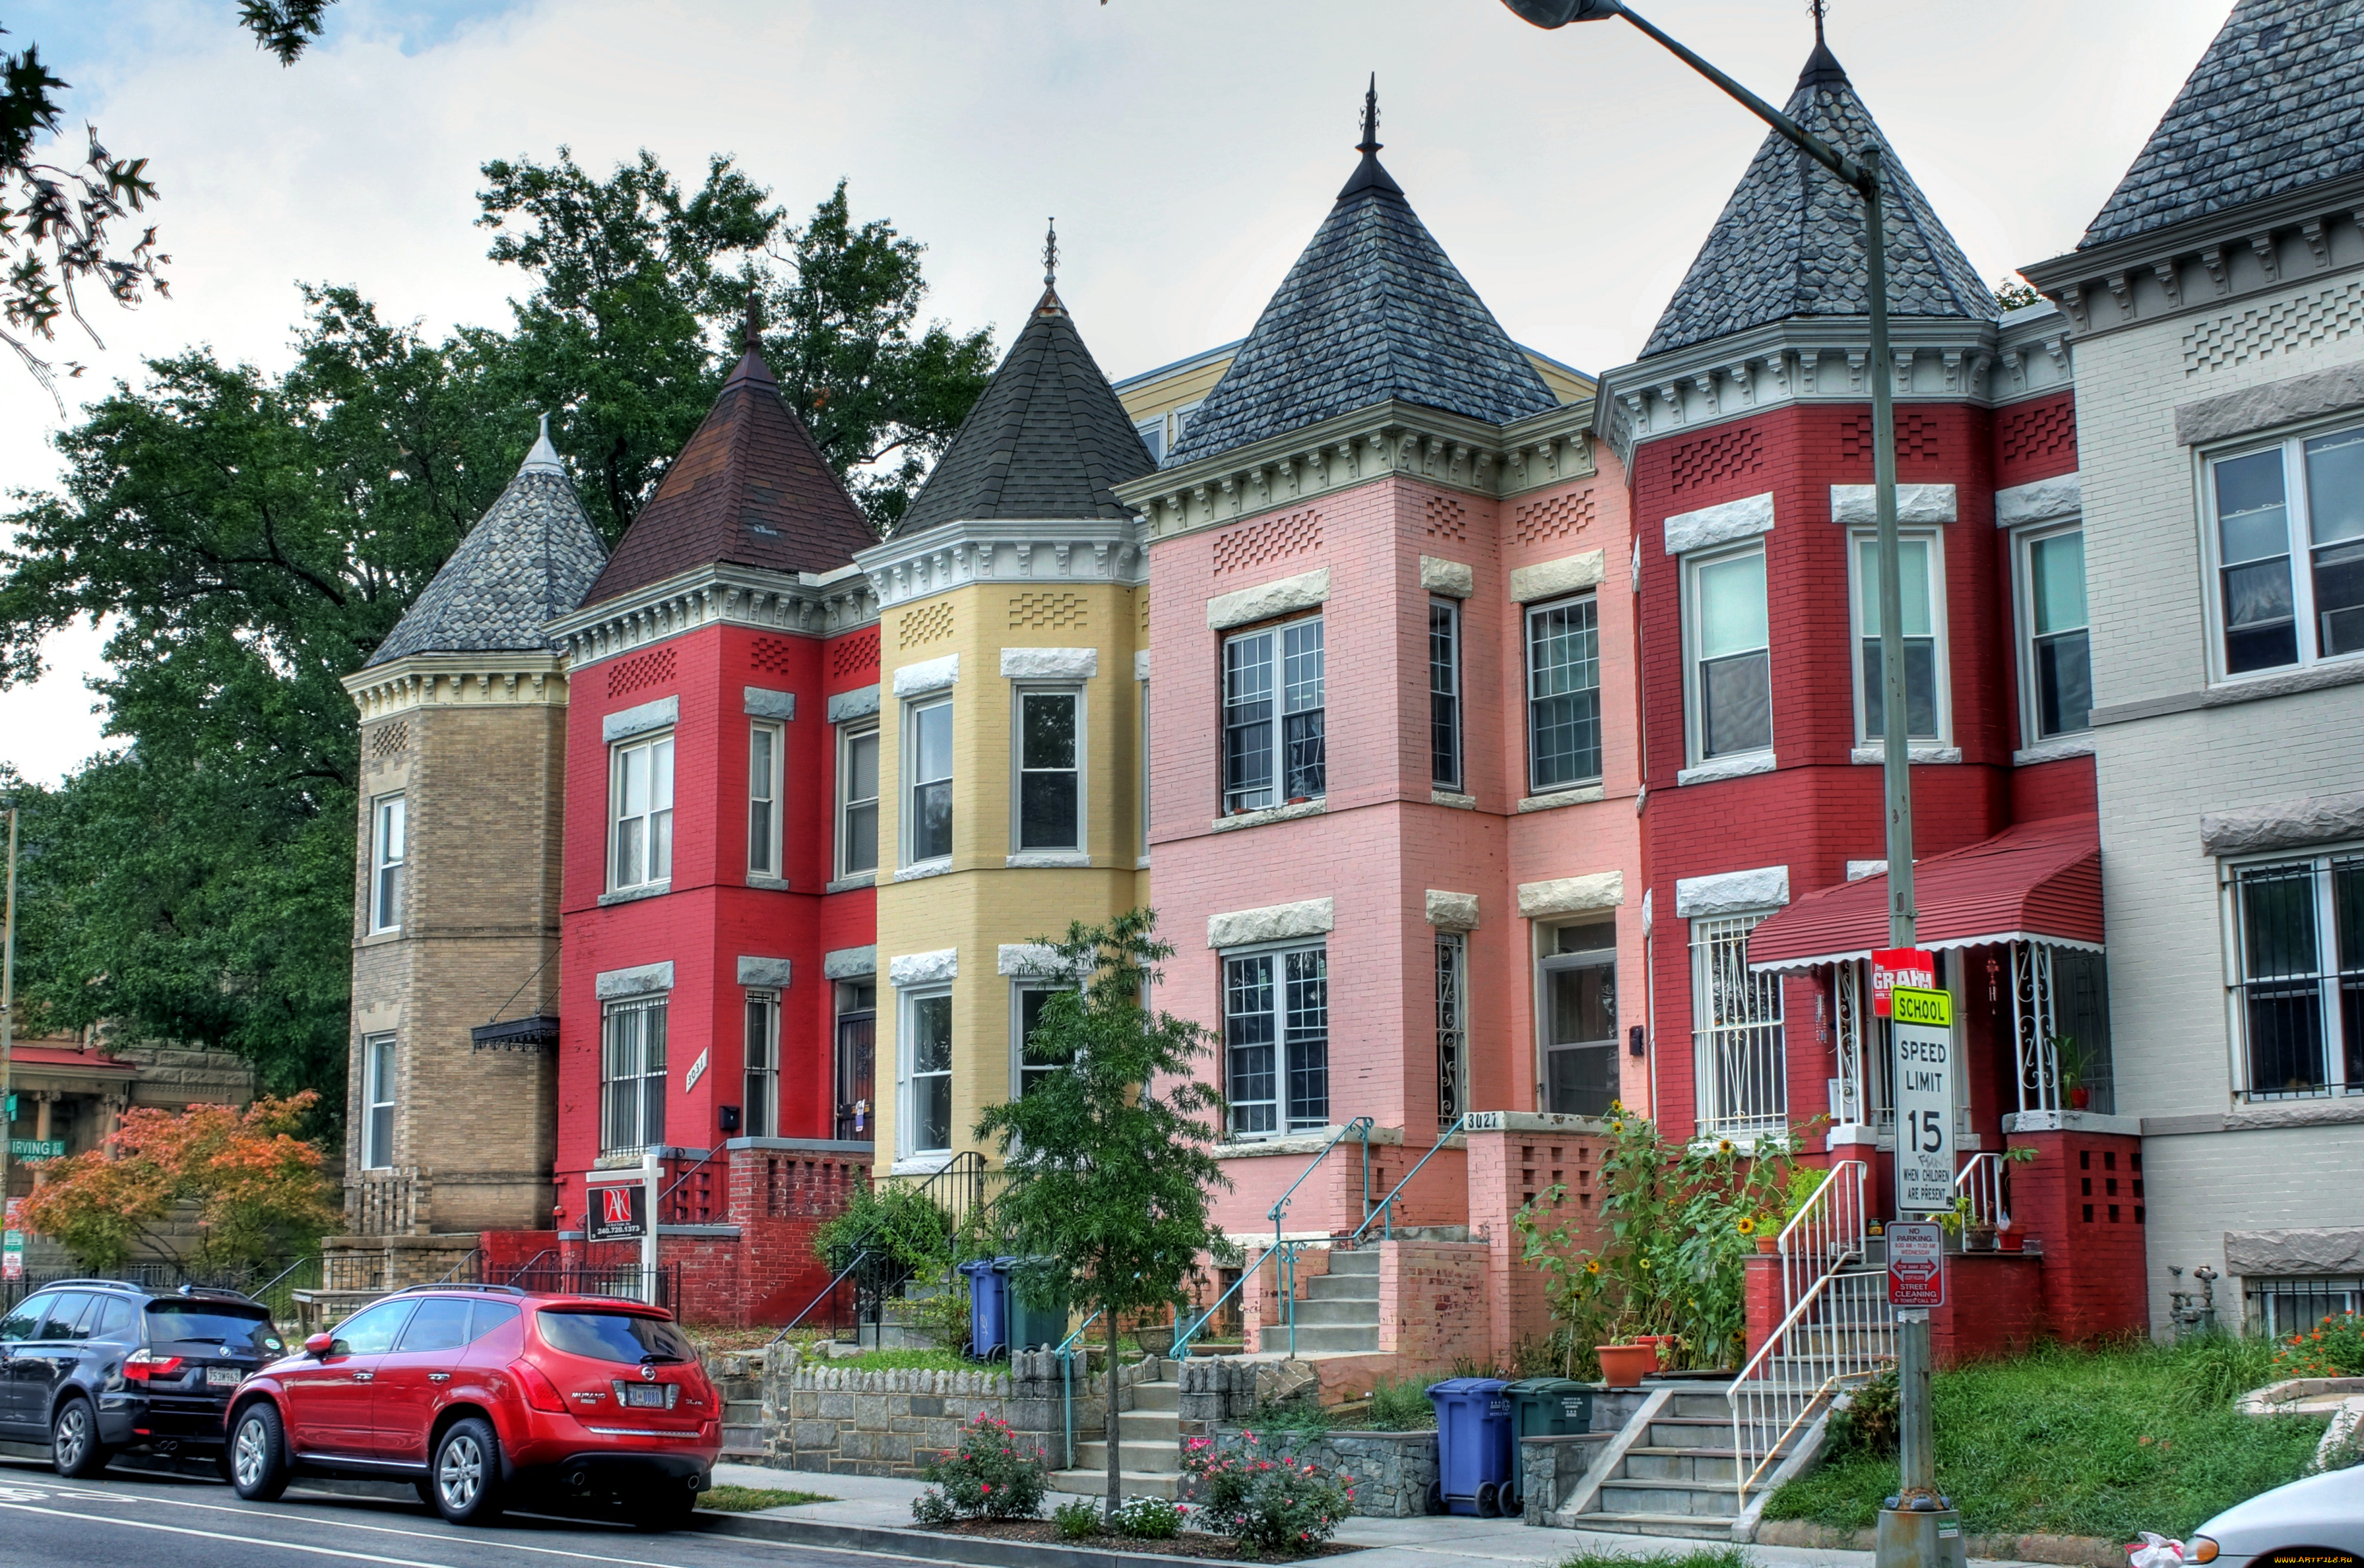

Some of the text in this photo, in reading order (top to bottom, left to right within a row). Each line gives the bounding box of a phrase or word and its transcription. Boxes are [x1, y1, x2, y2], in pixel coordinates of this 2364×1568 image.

[1899, 997, 1945, 1021] SCHOOL
[1900, 1040, 1946, 1063] SPEED
[688, 1057, 704, 1086] 3031
[1906, 1070, 1942, 1092] LIMIT
[1468, 1113, 1496, 1129] 3027
[1907, 1109, 1942, 1153] 15
[12, 1141, 49, 1154] IRVING
[1903, 1168, 1949, 1182] WHEN CHILDREN
[1907, 1187, 1946, 1201] ARE PRESENT
[597, 1224, 640, 1235] 240.720.1373
